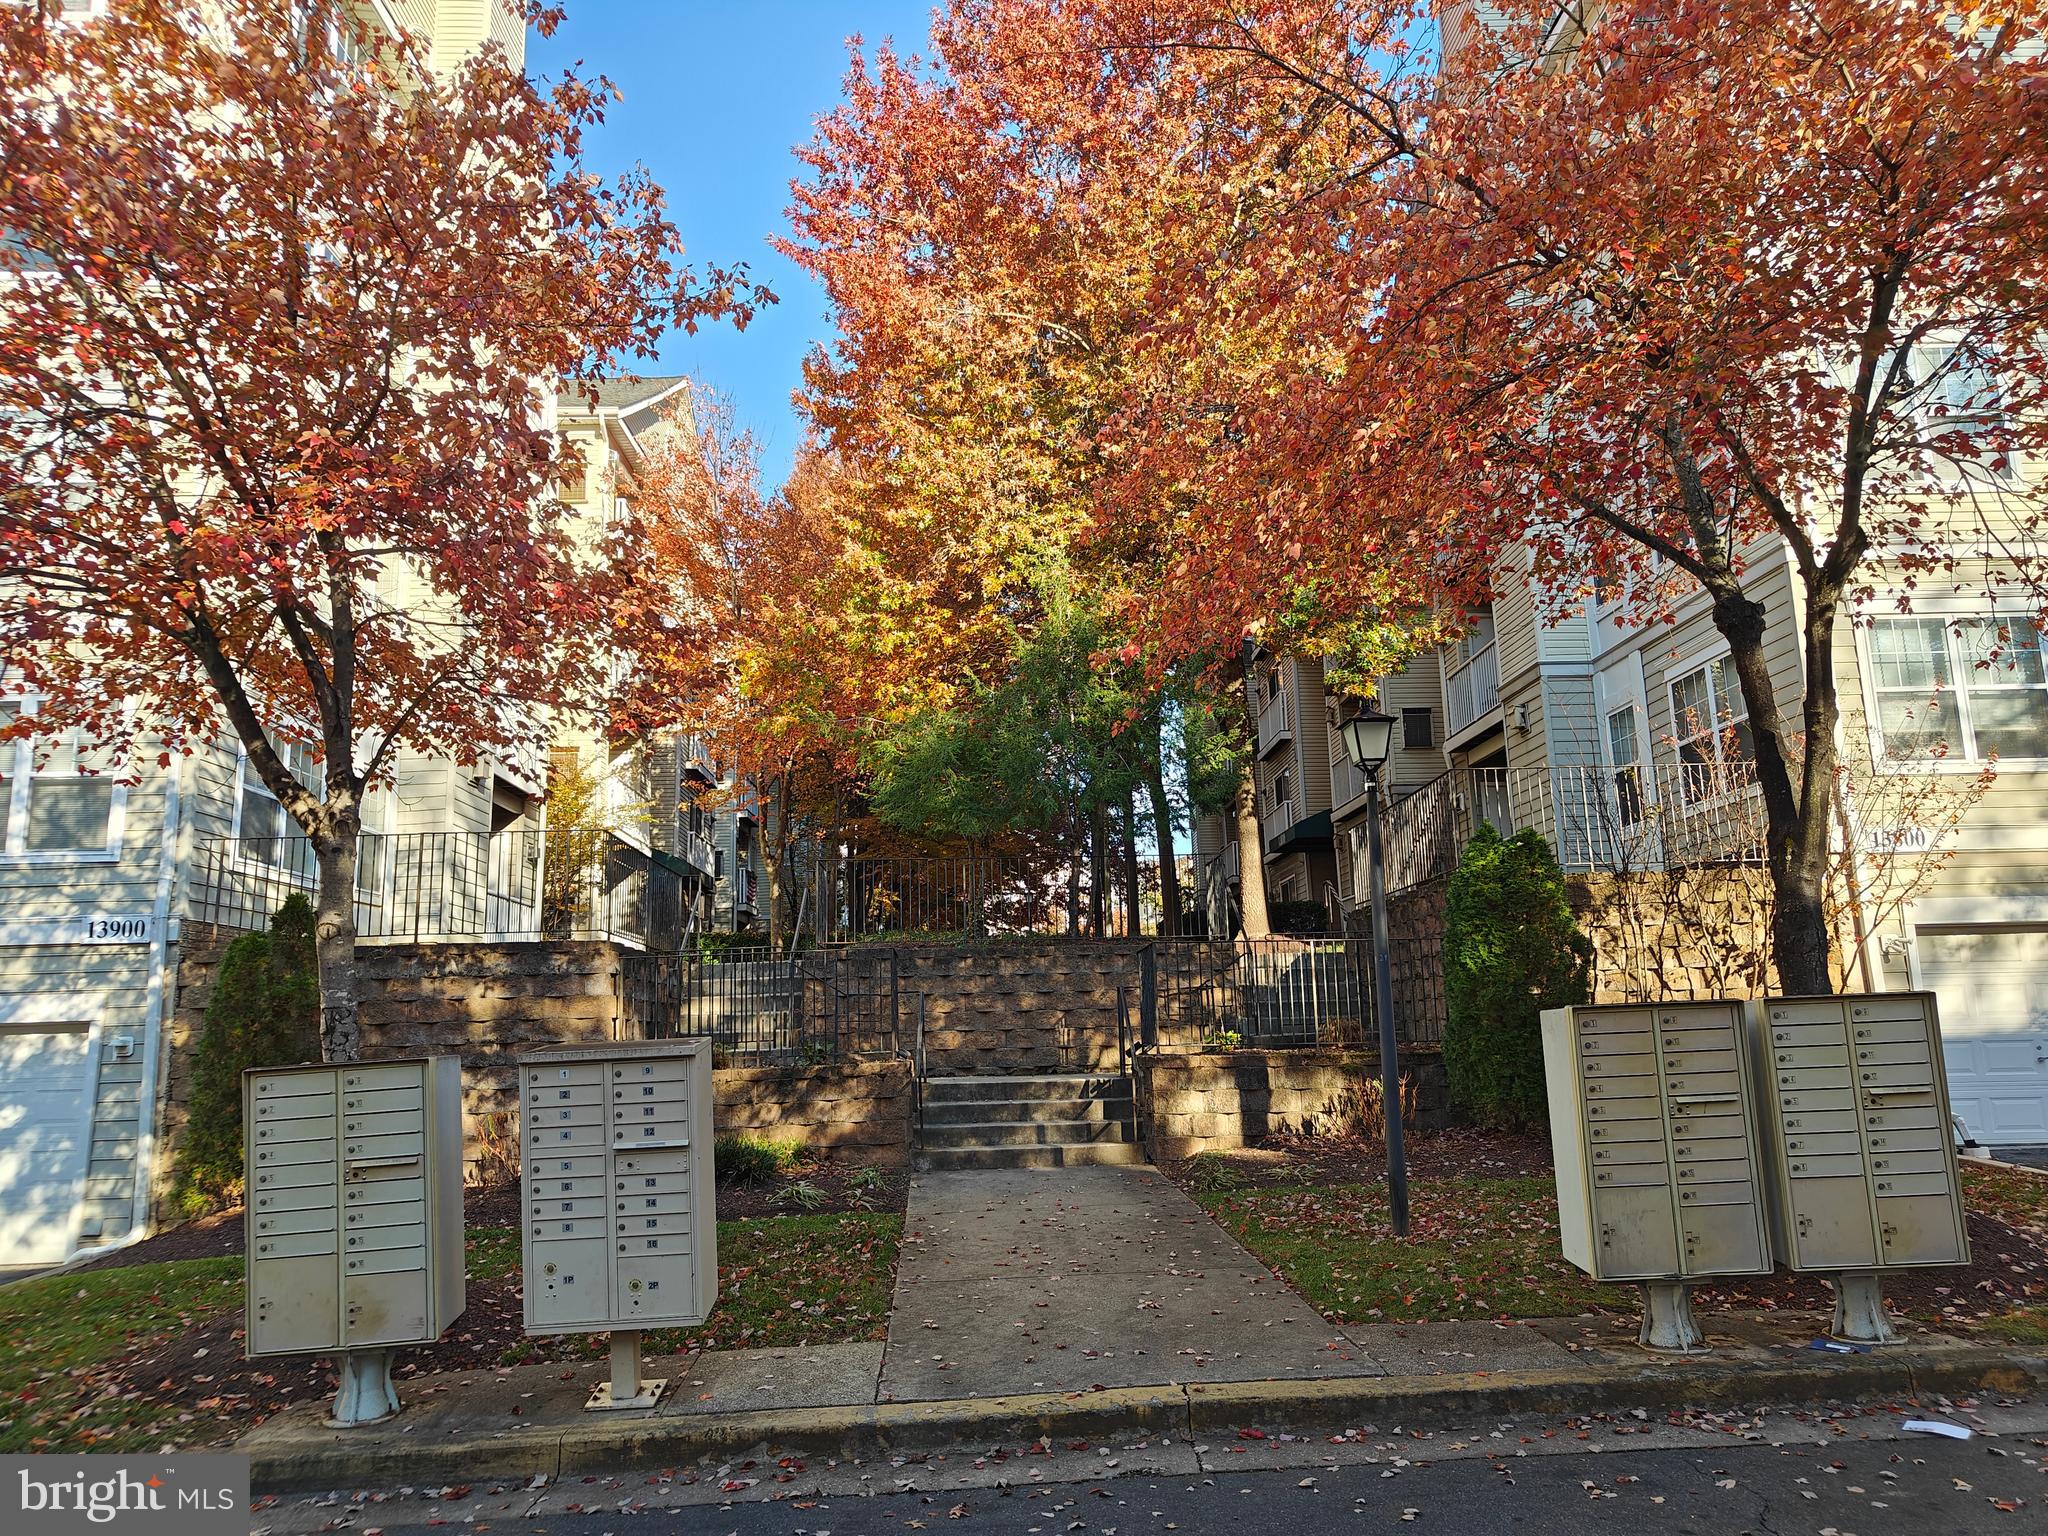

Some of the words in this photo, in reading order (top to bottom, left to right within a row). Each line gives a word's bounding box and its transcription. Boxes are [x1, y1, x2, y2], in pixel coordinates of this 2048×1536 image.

[88, 920, 145, 939] 13900
[644, 1087, 654, 1095] 10
[645, 1107, 654, 1115] 11
[645, 1127, 654, 1136] 12
[646, 1178, 656, 1187] 13
[647, 1219, 656, 1227] 15
[648, 1240, 657, 1248] 16
[564, 1276, 574, 1284] 1P
[648, 1281, 658, 1290] 2P
